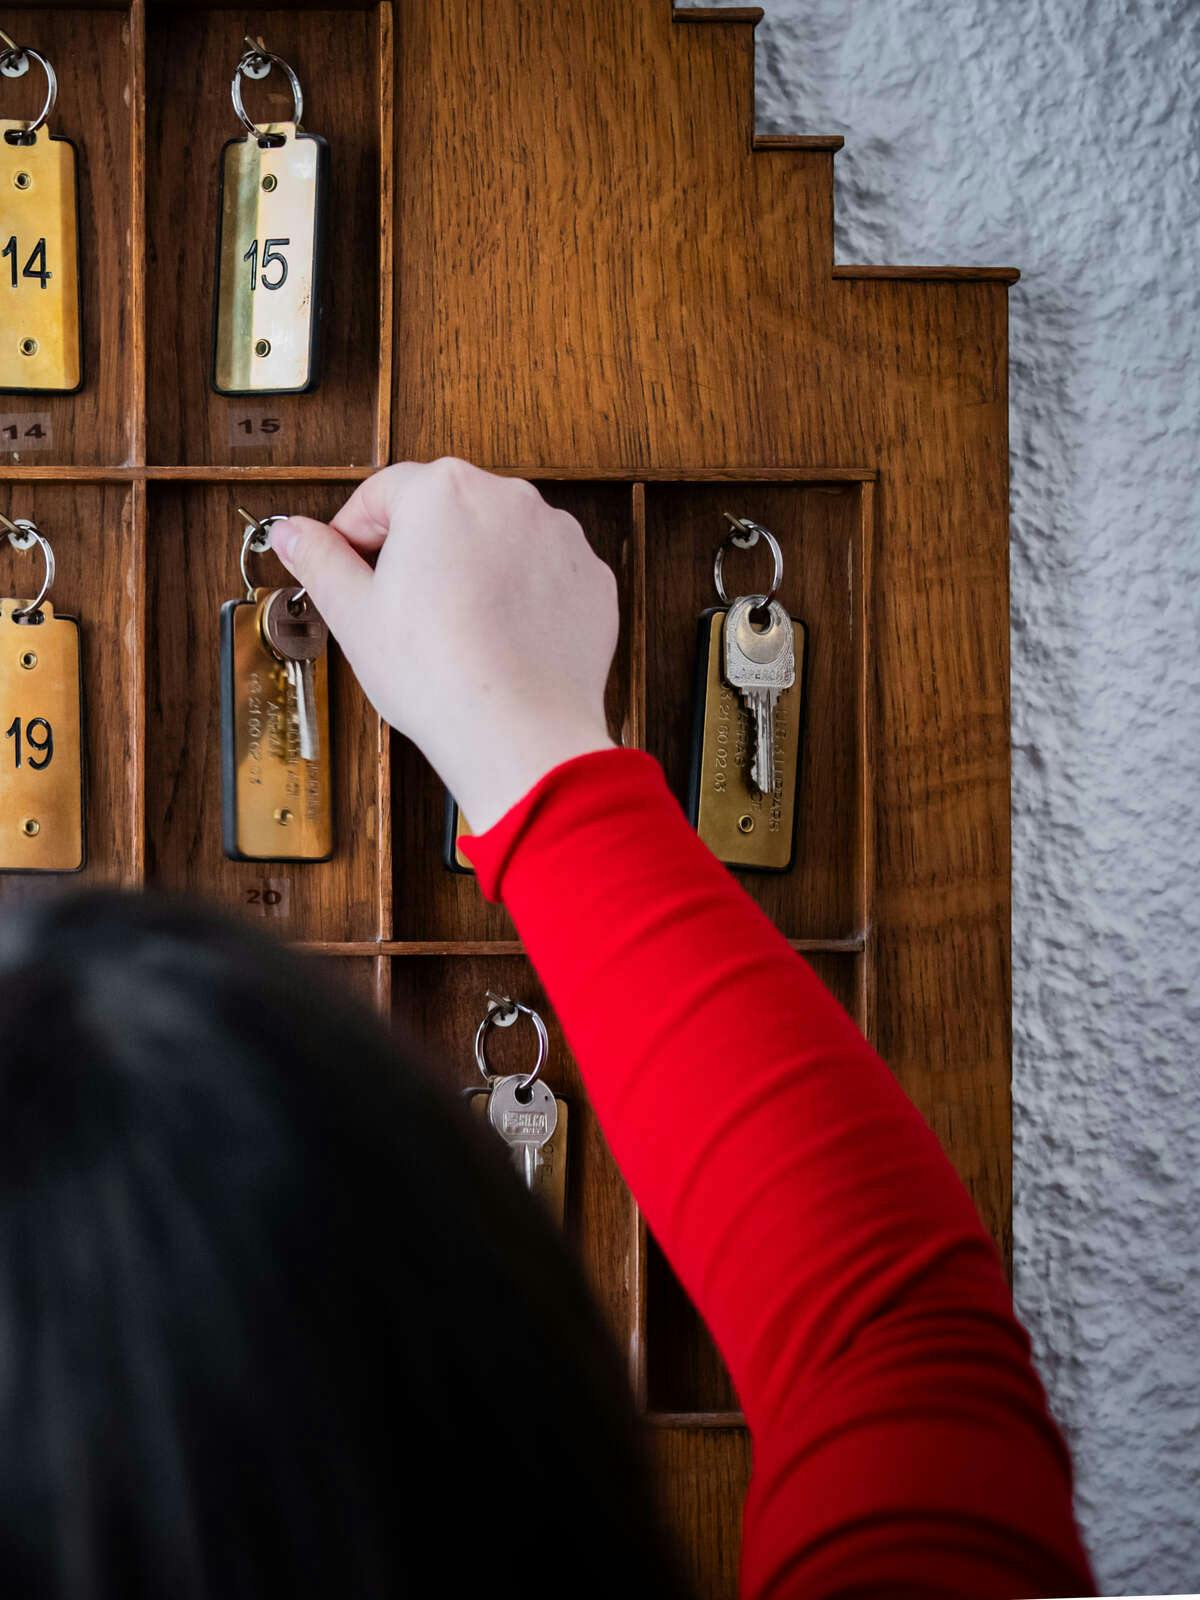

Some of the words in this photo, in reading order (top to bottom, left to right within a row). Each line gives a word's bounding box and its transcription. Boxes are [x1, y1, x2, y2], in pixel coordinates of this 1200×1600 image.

[1, 235, 53, 290] 14
[242, 237, 290, 291] 15
[1, 422, 46, 441] 14
[237, 416, 281, 436] 15
[718, 704, 731, 721] 21
[5, 716, 54, 771] 19
[714, 748, 728, 769] 02
[713, 772, 727, 793] 03
[246, 888, 282, 906] 20
